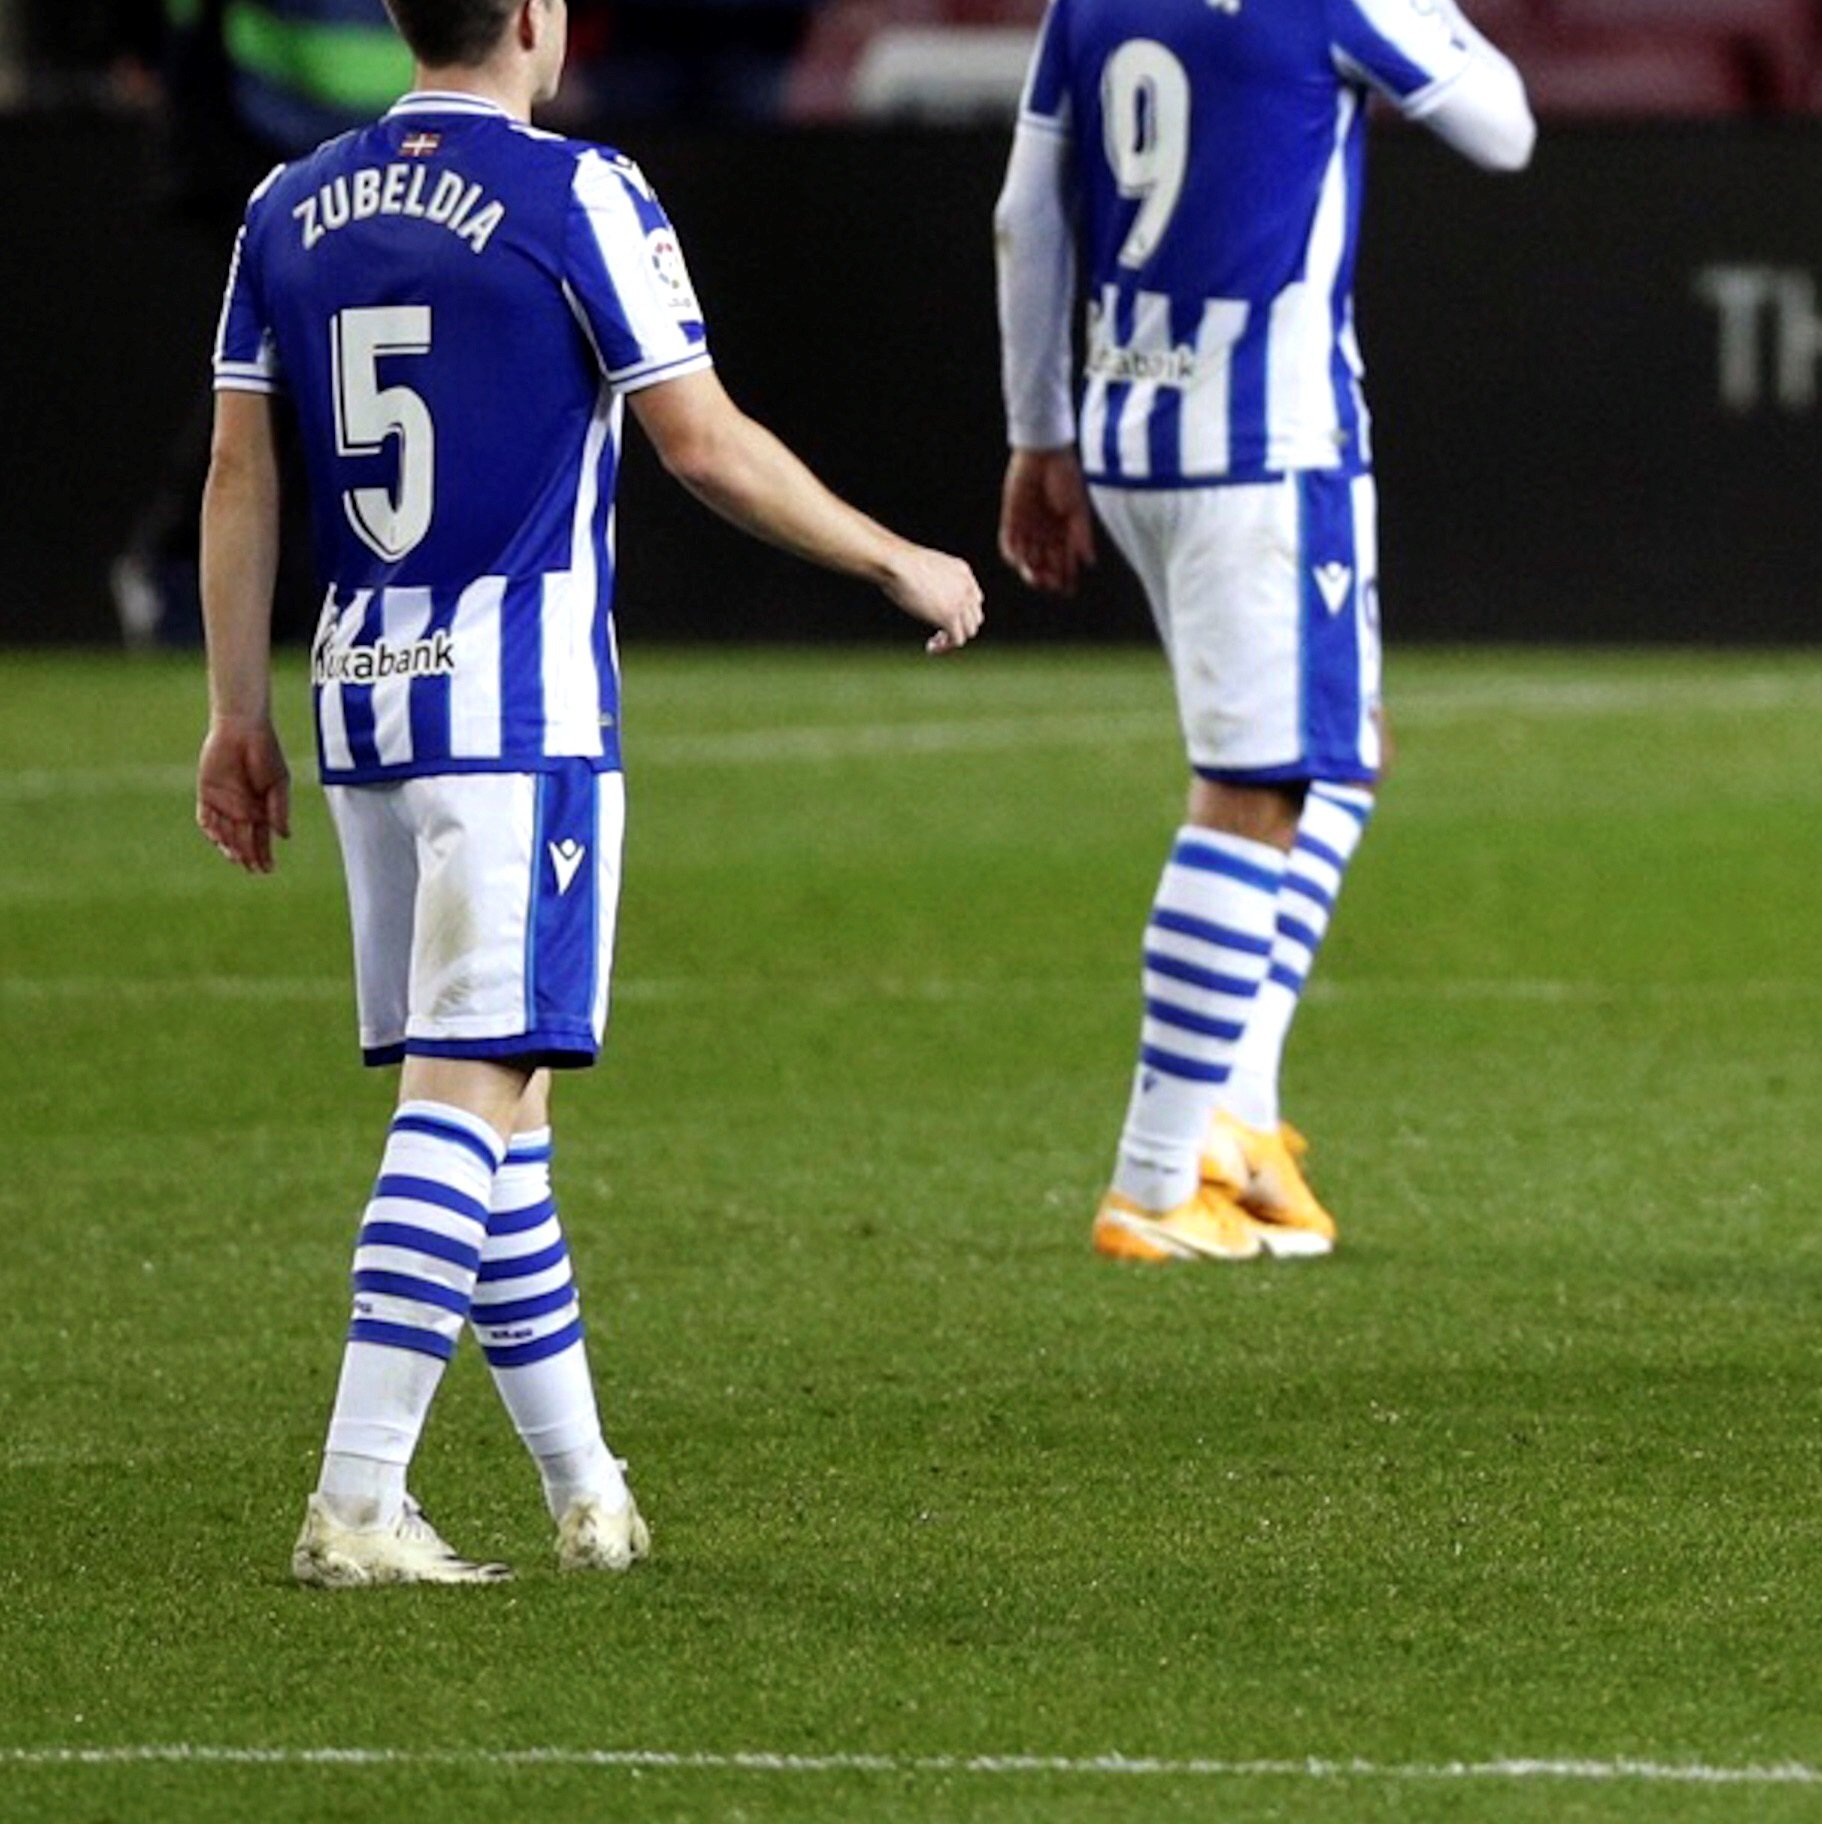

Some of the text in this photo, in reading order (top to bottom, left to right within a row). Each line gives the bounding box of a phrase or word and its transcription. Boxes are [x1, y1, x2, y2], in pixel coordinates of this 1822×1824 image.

[292, 162, 506, 254] ZUBELDIA
[1100, 37, 1192, 269] 9
[330, 305, 435, 562] 5
